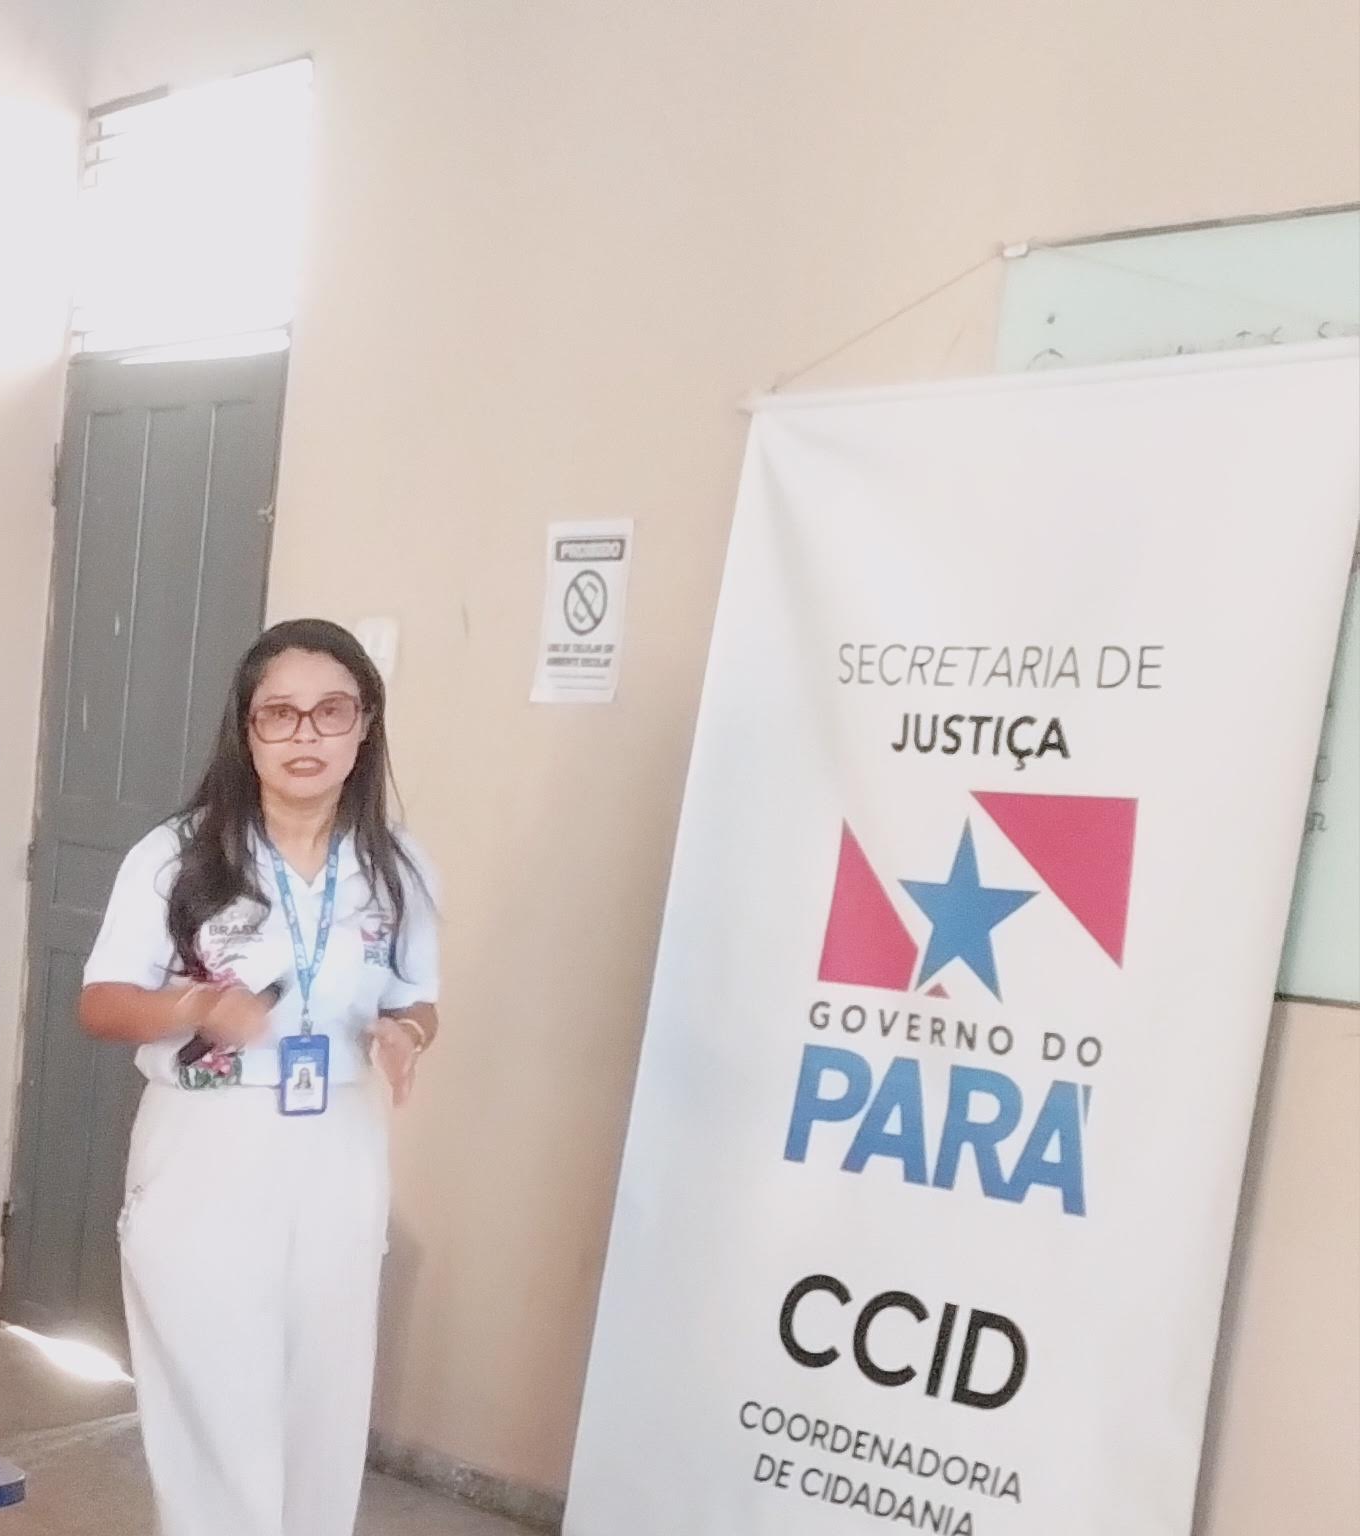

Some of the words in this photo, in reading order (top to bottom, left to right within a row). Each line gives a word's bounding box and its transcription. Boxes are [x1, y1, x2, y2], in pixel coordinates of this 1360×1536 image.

[838, 643, 1081, 689] SECRETARIA
[1096, 645, 1164, 690] DE
[890, 712, 1071, 772] JUSTIÇA
[809, 1000, 1014, 1056] GOVERNO
[1041, 1031, 1103, 1068] DO
[784, 1043, 1092, 1217] PARÁ
[778, 1273, 1028, 1410] CCID
[739, 1400, 1022, 1504] COORDENADORIA
[752, 1453, 795, 1490] DE
